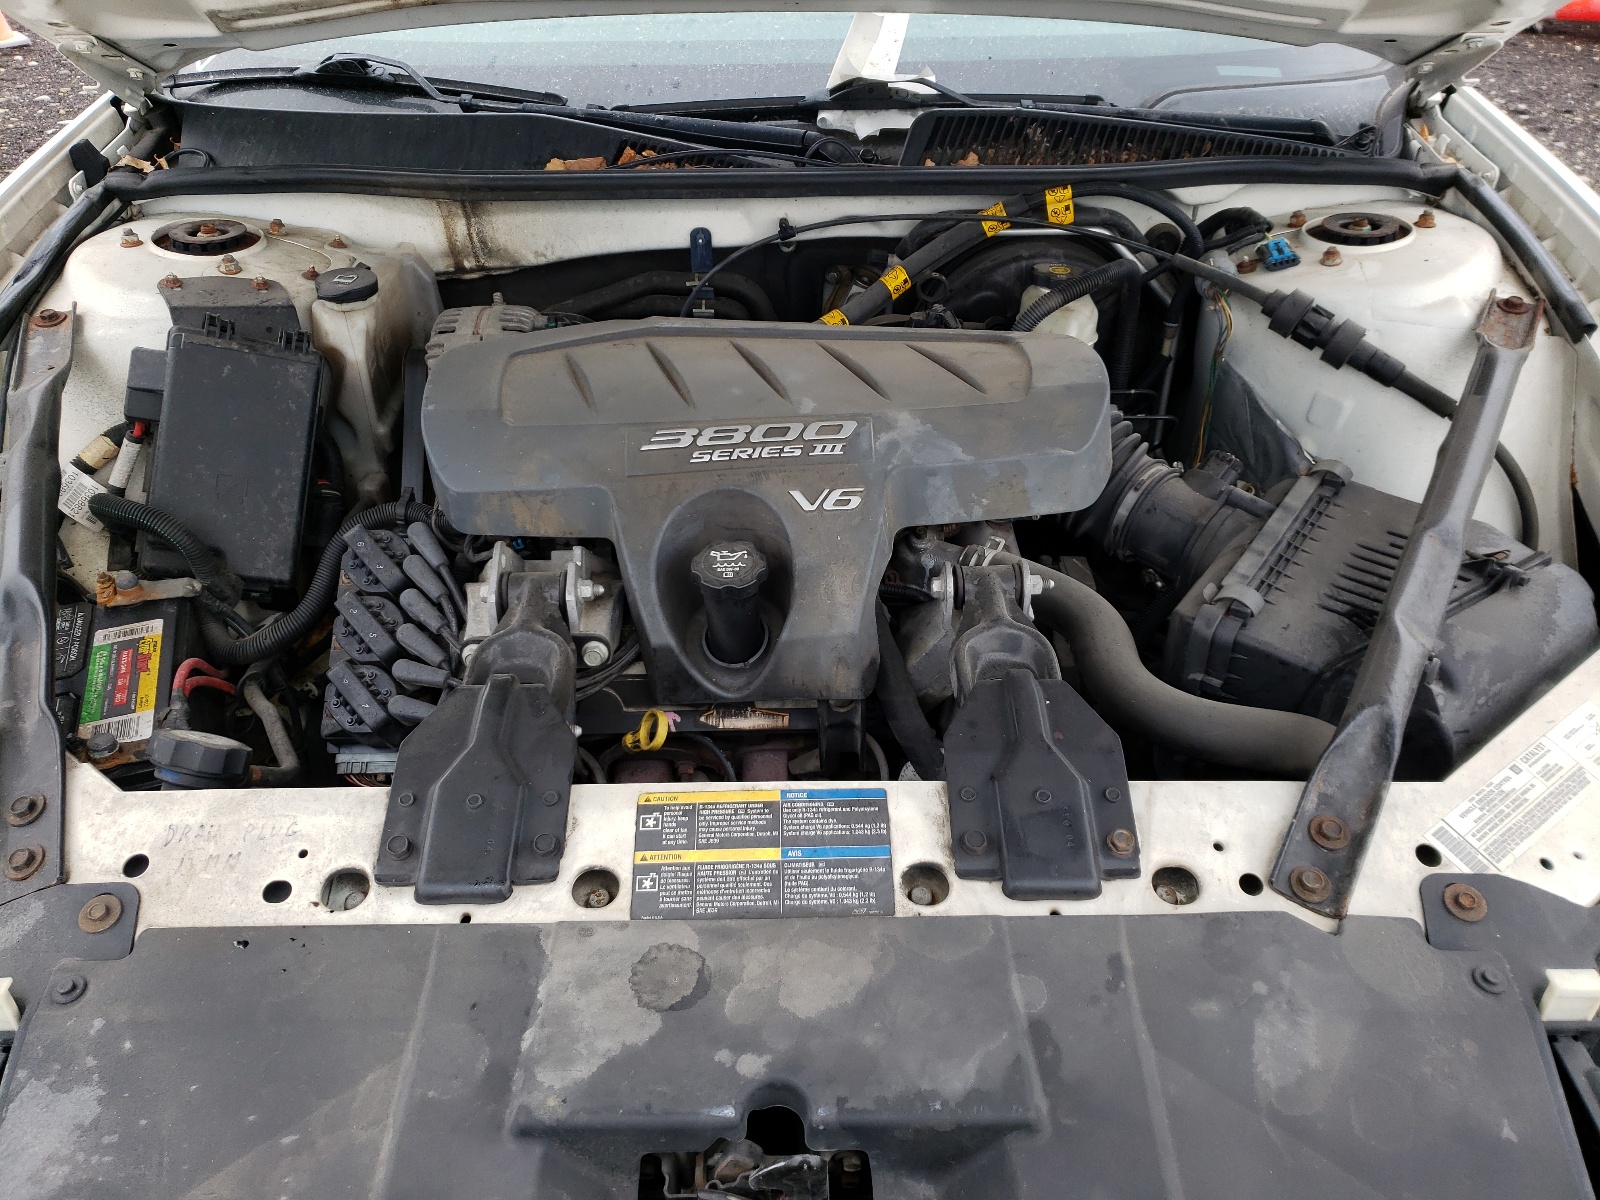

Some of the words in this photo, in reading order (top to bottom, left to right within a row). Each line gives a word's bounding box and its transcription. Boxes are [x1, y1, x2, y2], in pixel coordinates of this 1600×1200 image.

[640, 420, 857, 451] 3800
[690, 444, 803, 463] SERIES
[809, 443, 846, 455] III
[788, 488, 865, 511] V6
[1519, 741, 1547, 764] CATALYST
[243, 821, 302, 842] PLUG
